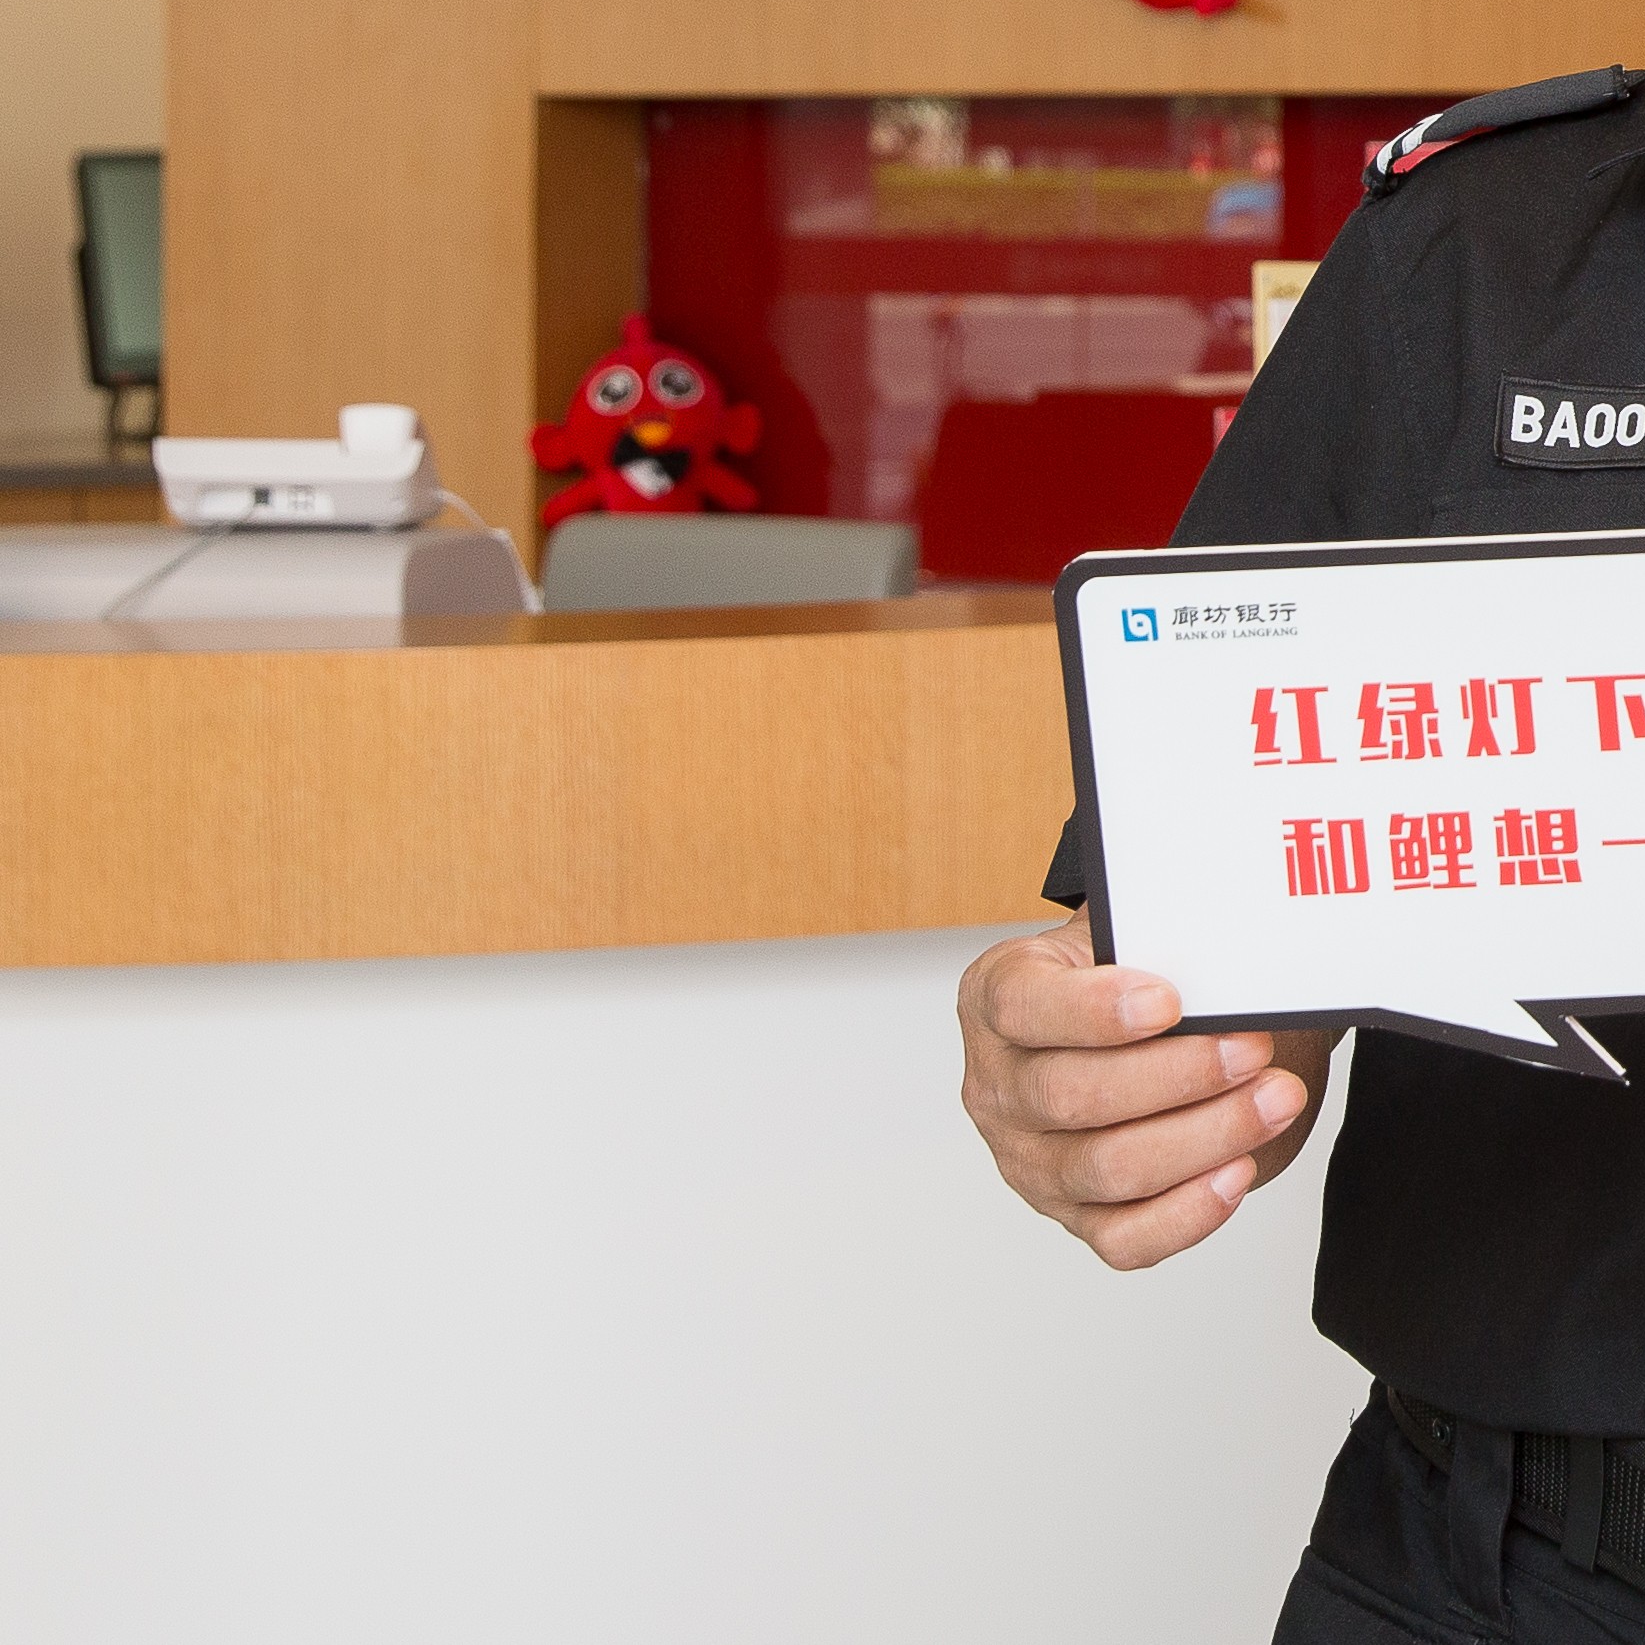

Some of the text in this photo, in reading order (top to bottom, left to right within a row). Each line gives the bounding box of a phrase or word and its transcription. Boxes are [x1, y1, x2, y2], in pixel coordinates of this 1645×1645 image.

[1171, 602, 1298, 628] 廊坊银行
[1175, 626, 1299, 641] BANK OF LANGFANG
